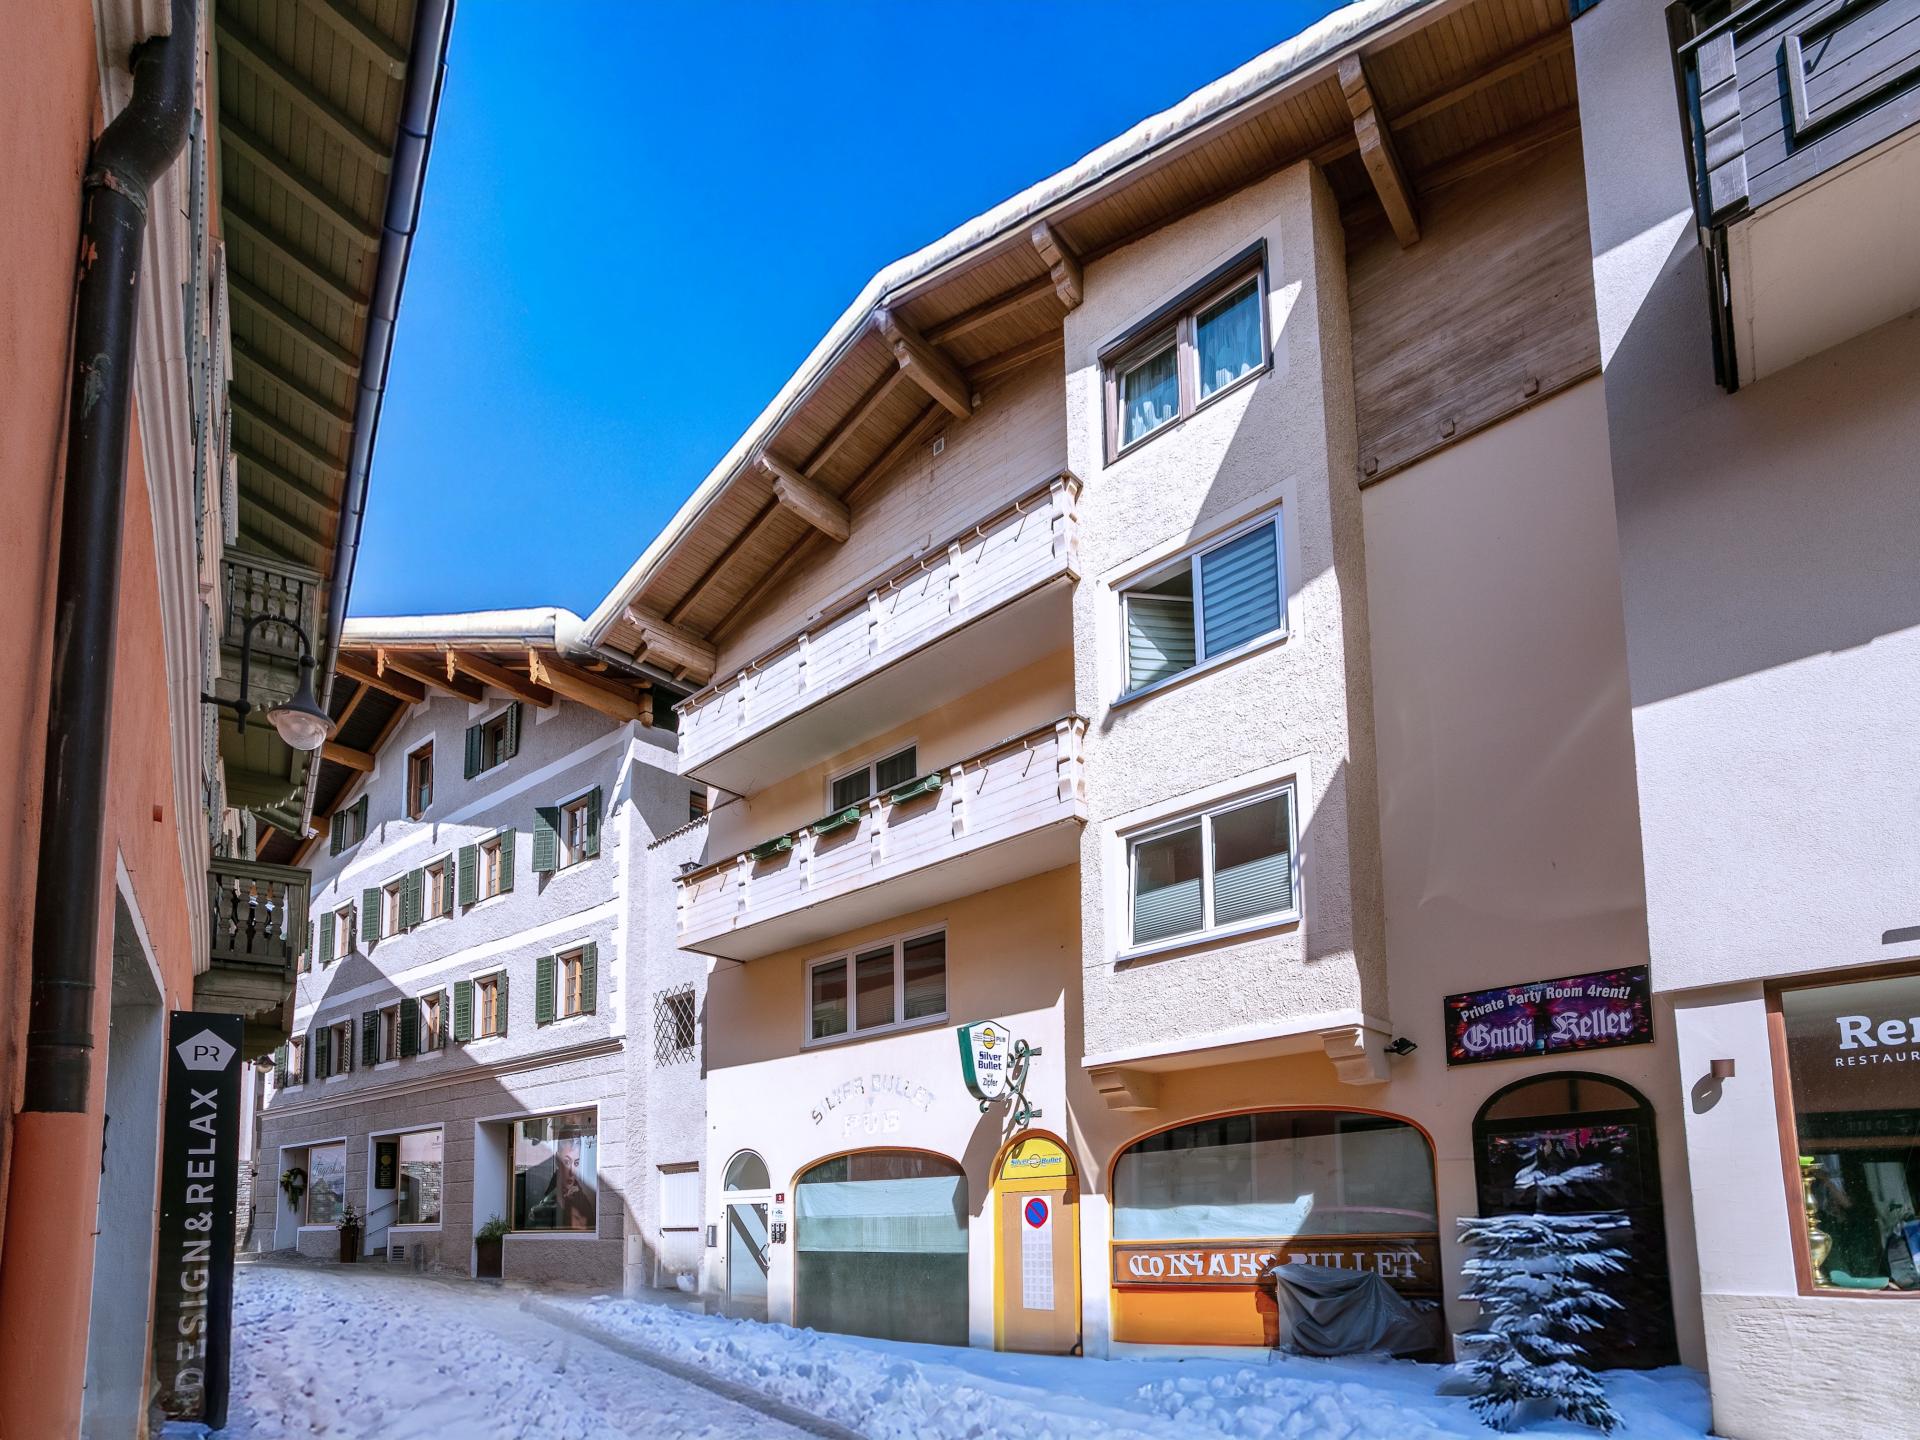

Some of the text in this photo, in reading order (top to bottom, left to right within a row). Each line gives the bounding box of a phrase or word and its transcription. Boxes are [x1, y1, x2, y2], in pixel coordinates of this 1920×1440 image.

[1460, 984, 1631, 1022] Private Party Room 4rent!
[1463, 1009, 1632, 1051] Gaudi Keller
[194, 1045, 220, 1062] PR
[979, 1051, 1002, 1061] Silver
[978, 1060, 1002, 1070] Bullet
[982, 1078, 998, 1088] Zipfer
[174, 1088, 218, 1391] DESIGN & RELAX
